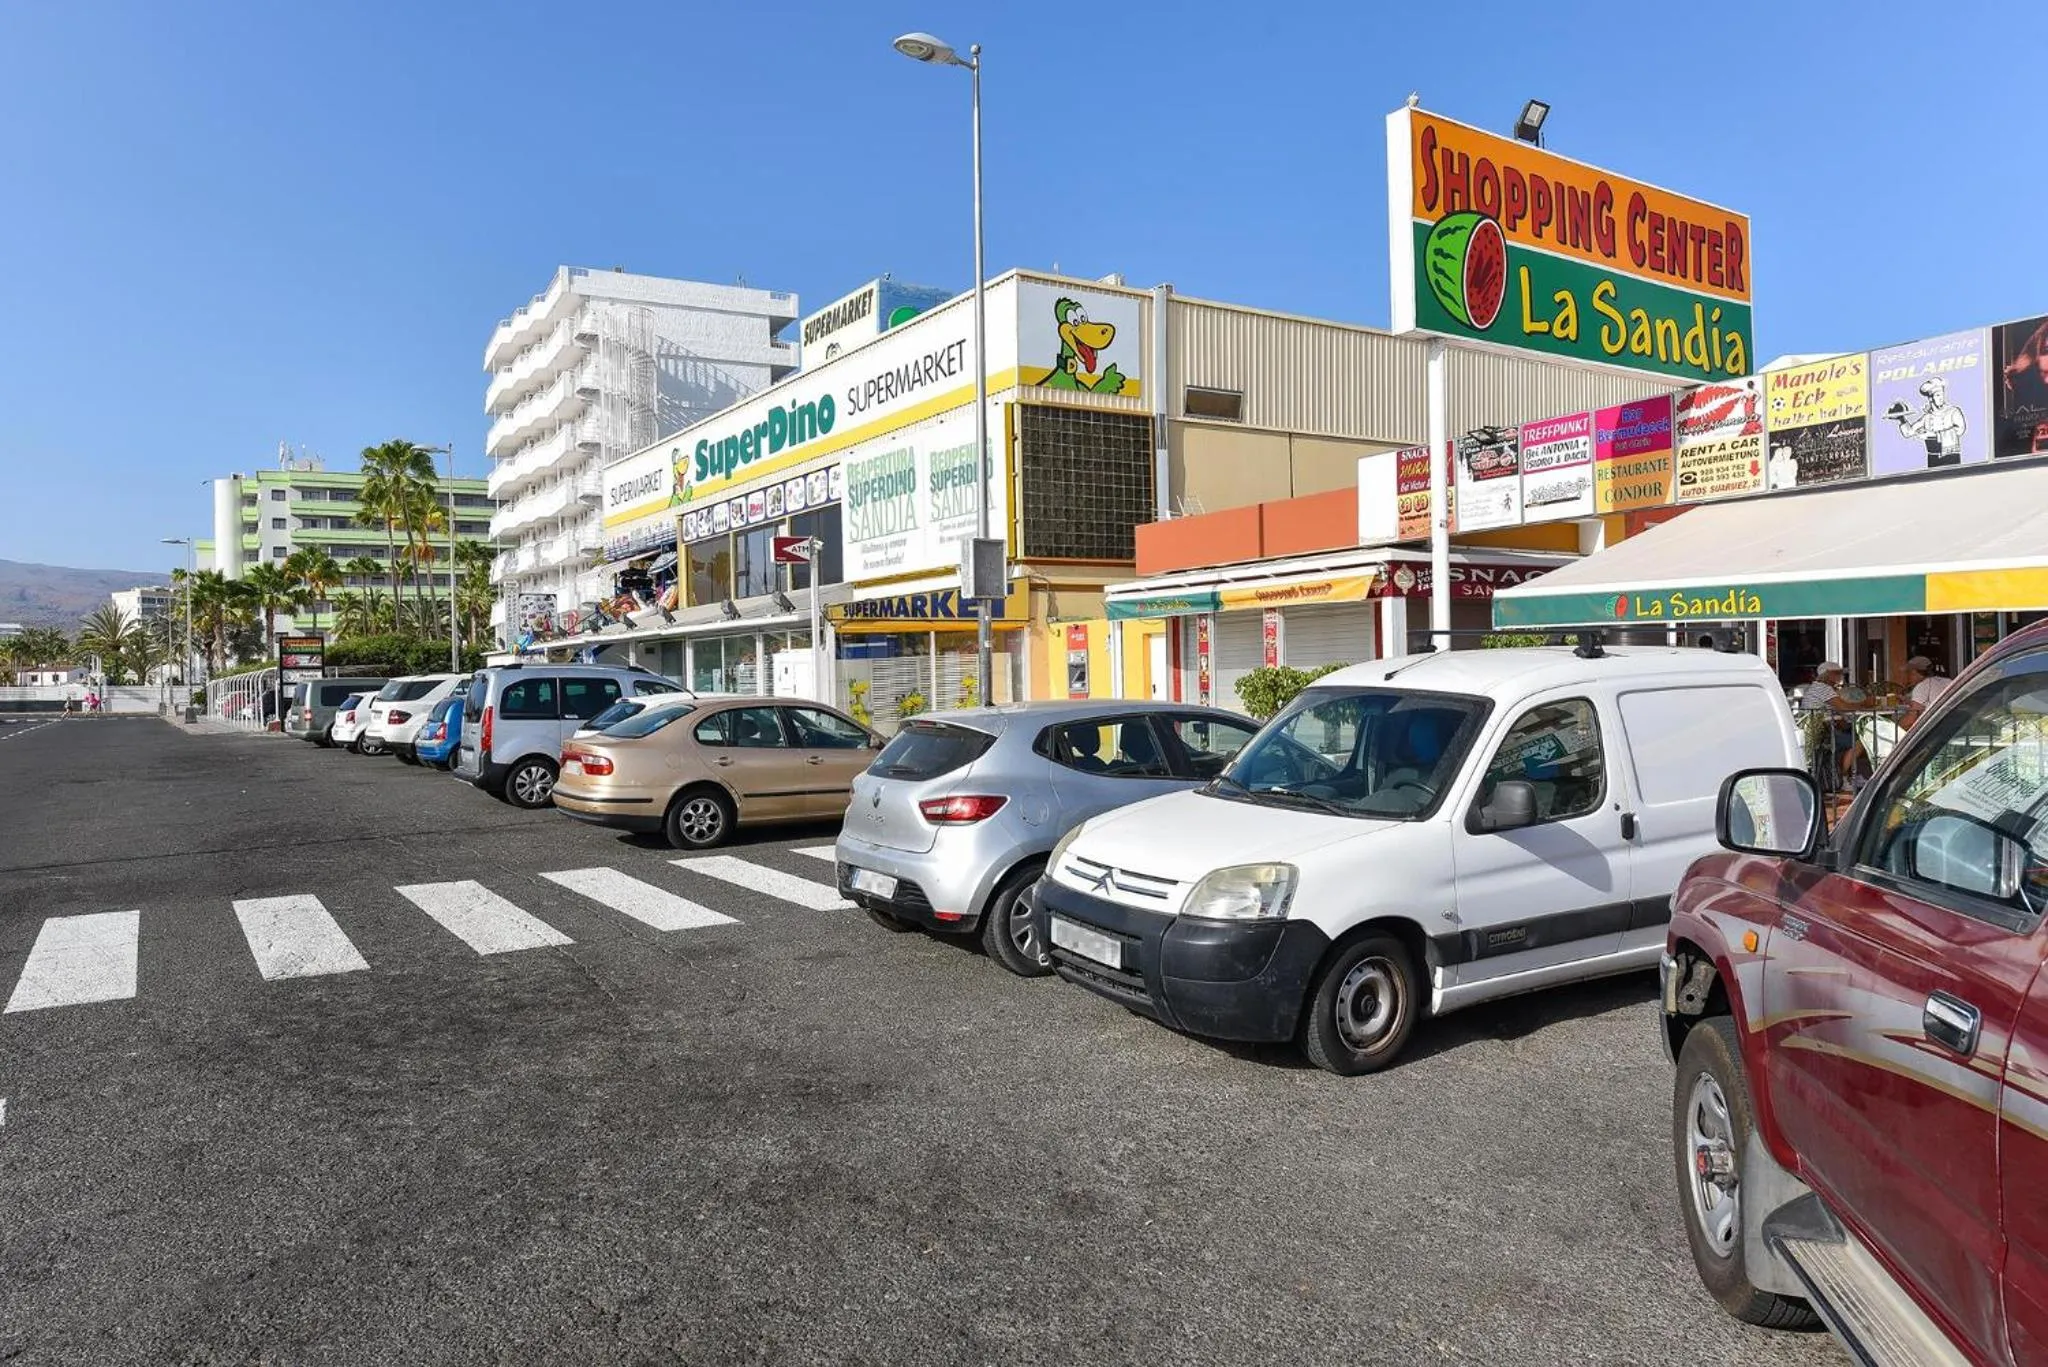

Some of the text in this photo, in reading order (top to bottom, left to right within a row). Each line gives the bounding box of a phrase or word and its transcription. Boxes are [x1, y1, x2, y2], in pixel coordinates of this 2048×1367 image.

[1421, 125, 1744, 293] SHOPPING CENTER
[804, 288, 874, 347] SUPERMARKET
[1519, 264, 1747, 377] La Sandía
[847, 338, 967, 416] SUPERMARKET
[1772, 361, 1862, 392] Manolo's
[1876, 353, 1980, 384] POLARIS
[695, 394, 836, 481] SuperDino
[1523, 417, 1589, 442] TREFFPUNKT
[1401, 447, 1430, 462] SNACK
[1540, 439, 1580, 456] ANTONIA
[1680, 437, 1760, 458] RENT A CAR
[1681, 449, 1760, 469] AUTOVERMIETUNG
[847, 446, 916, 484] REAPERTURA
[930, 457, 993, 493] SUPERDIO
[1598, 457, 1669, 480] RESTAURANTE
[610, 468, 664, 508] SUPERMARKET
[848, 467, 916, 509] SUPERDINO
[930, 484, 997, 522] SANDA
[1605, 481, 1663, 503] CONDOR
[1681, 485, 1707, 497] AUTOS
[1636, 589, 1761, 617] La Sandía
